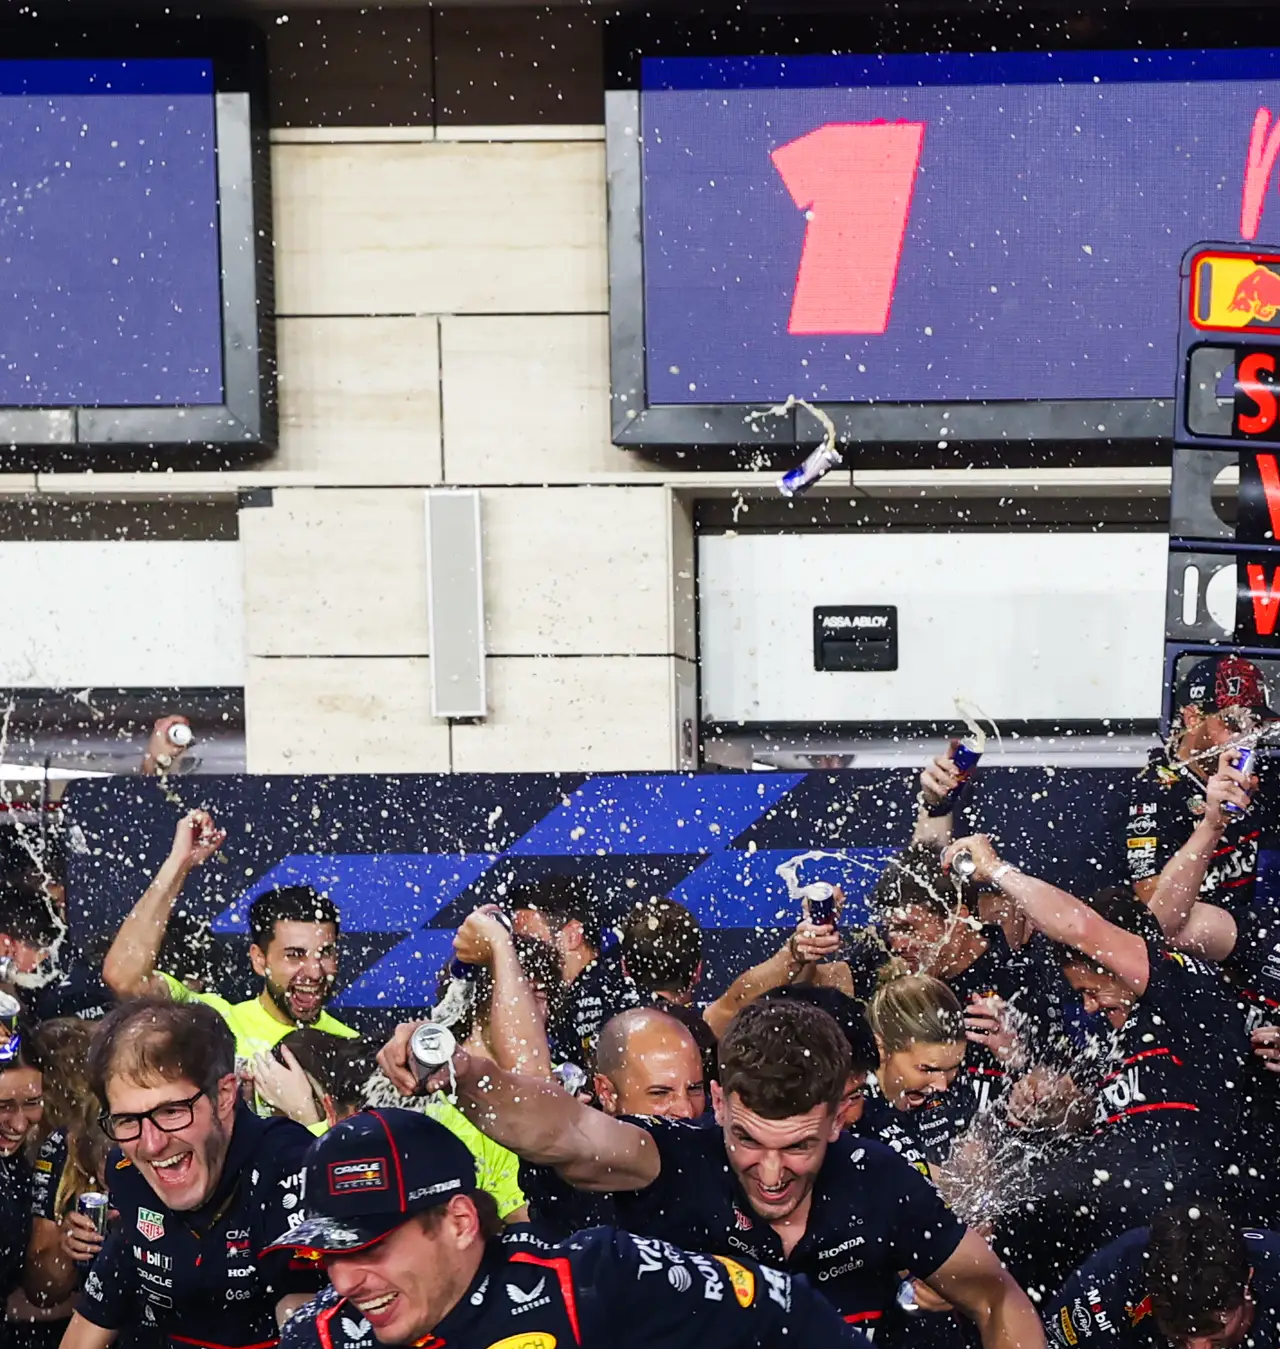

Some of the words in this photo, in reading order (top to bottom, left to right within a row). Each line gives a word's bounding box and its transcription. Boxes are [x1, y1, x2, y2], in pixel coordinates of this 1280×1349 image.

[768, 118, 926, 335] 1
[822, 616, 851, 627] ASSA
[852, 616, 888, 627] ABLOY
[576, 997, 601, 1008] VISA
[75, 1006, 105, 1020] VISA
[333, 1162, 380, 1175] ORACLE
[277, 1172, 304, 1189] VIS
[142, 1211, 163, 1225] TAG
[139, 1222, 165, 1239] HEUER
[133, 1245, 160, 1267] Mobil
[818, 1236, 865, 1260] HONDA
[511, 1296, 551, 1315] CASTORE
